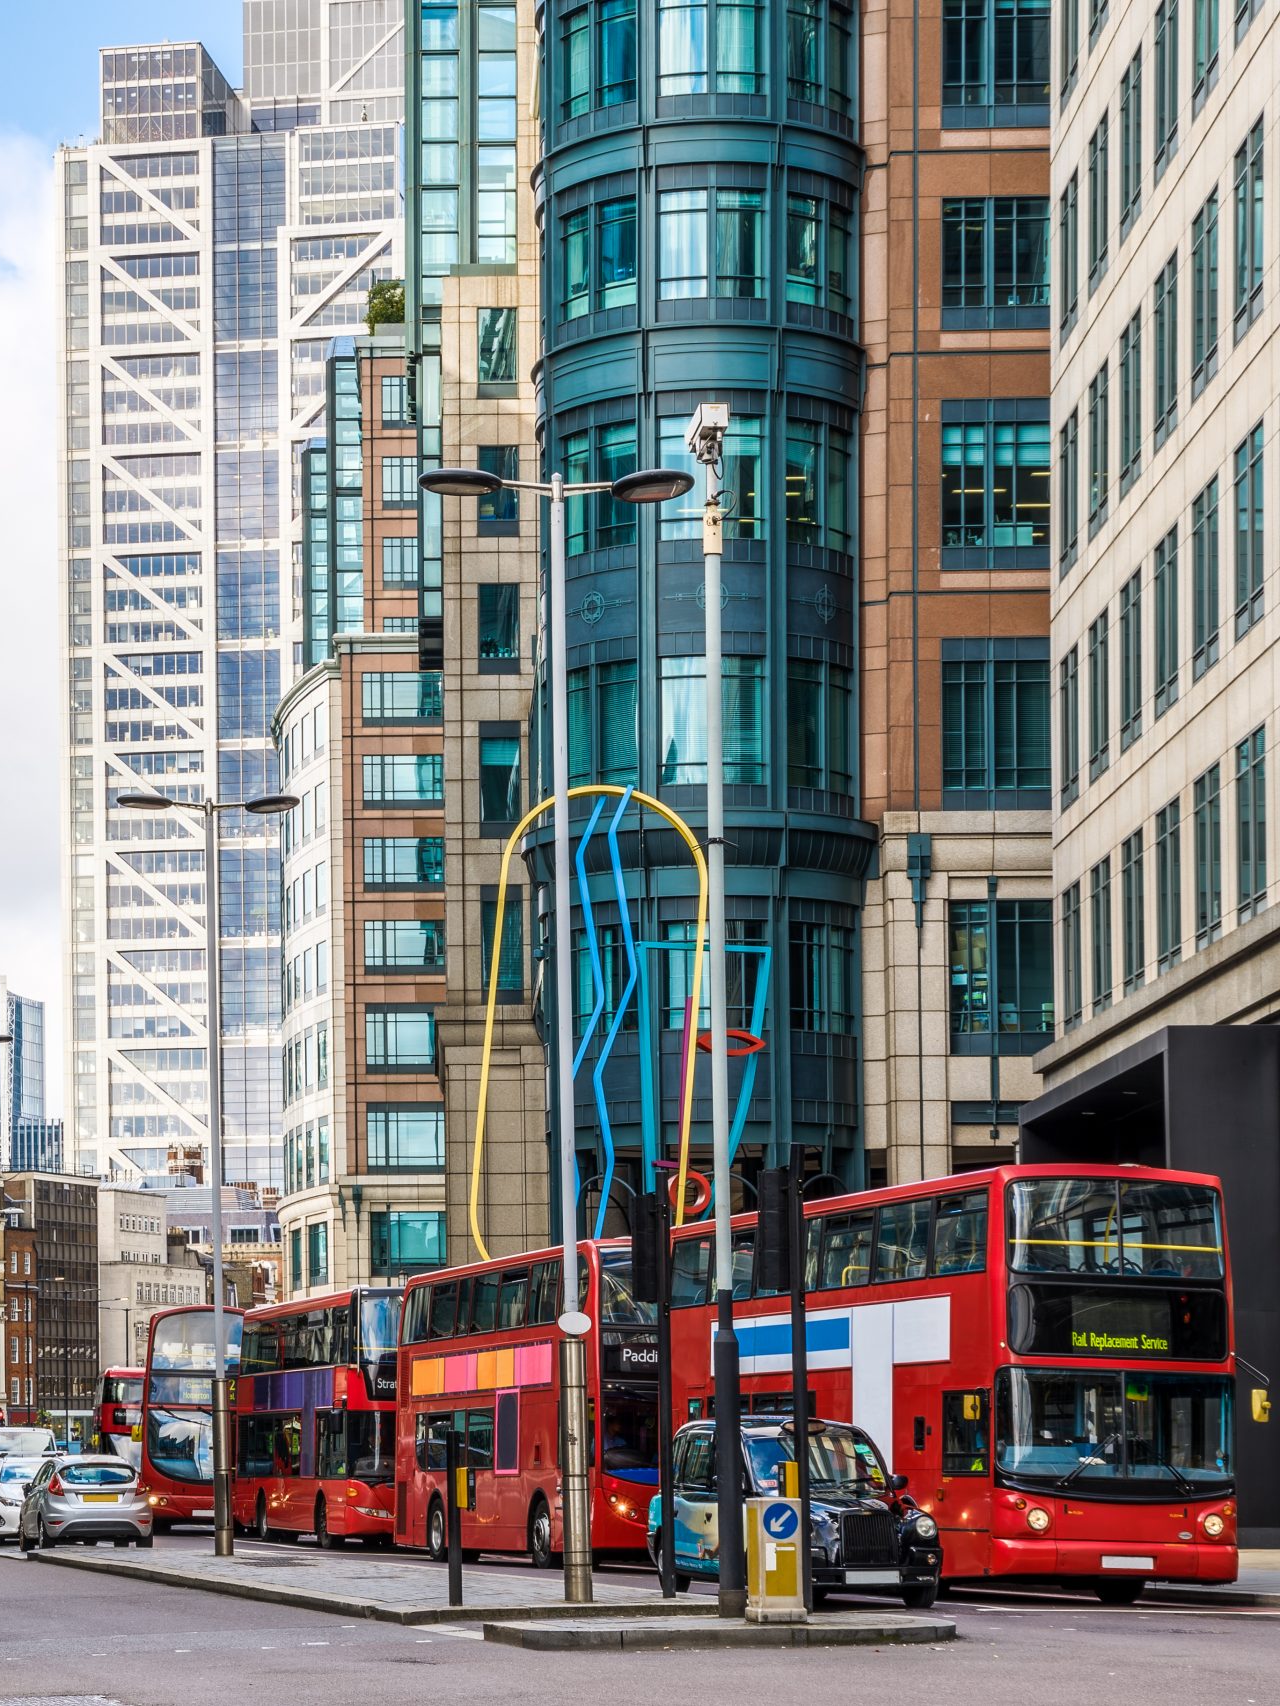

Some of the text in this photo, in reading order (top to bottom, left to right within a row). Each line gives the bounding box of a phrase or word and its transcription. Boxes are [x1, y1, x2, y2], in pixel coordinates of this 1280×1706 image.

[1072, 1331, 1168, 1351] Rail Replacement Service
[623, 1348, 658, 1363] Paddi
